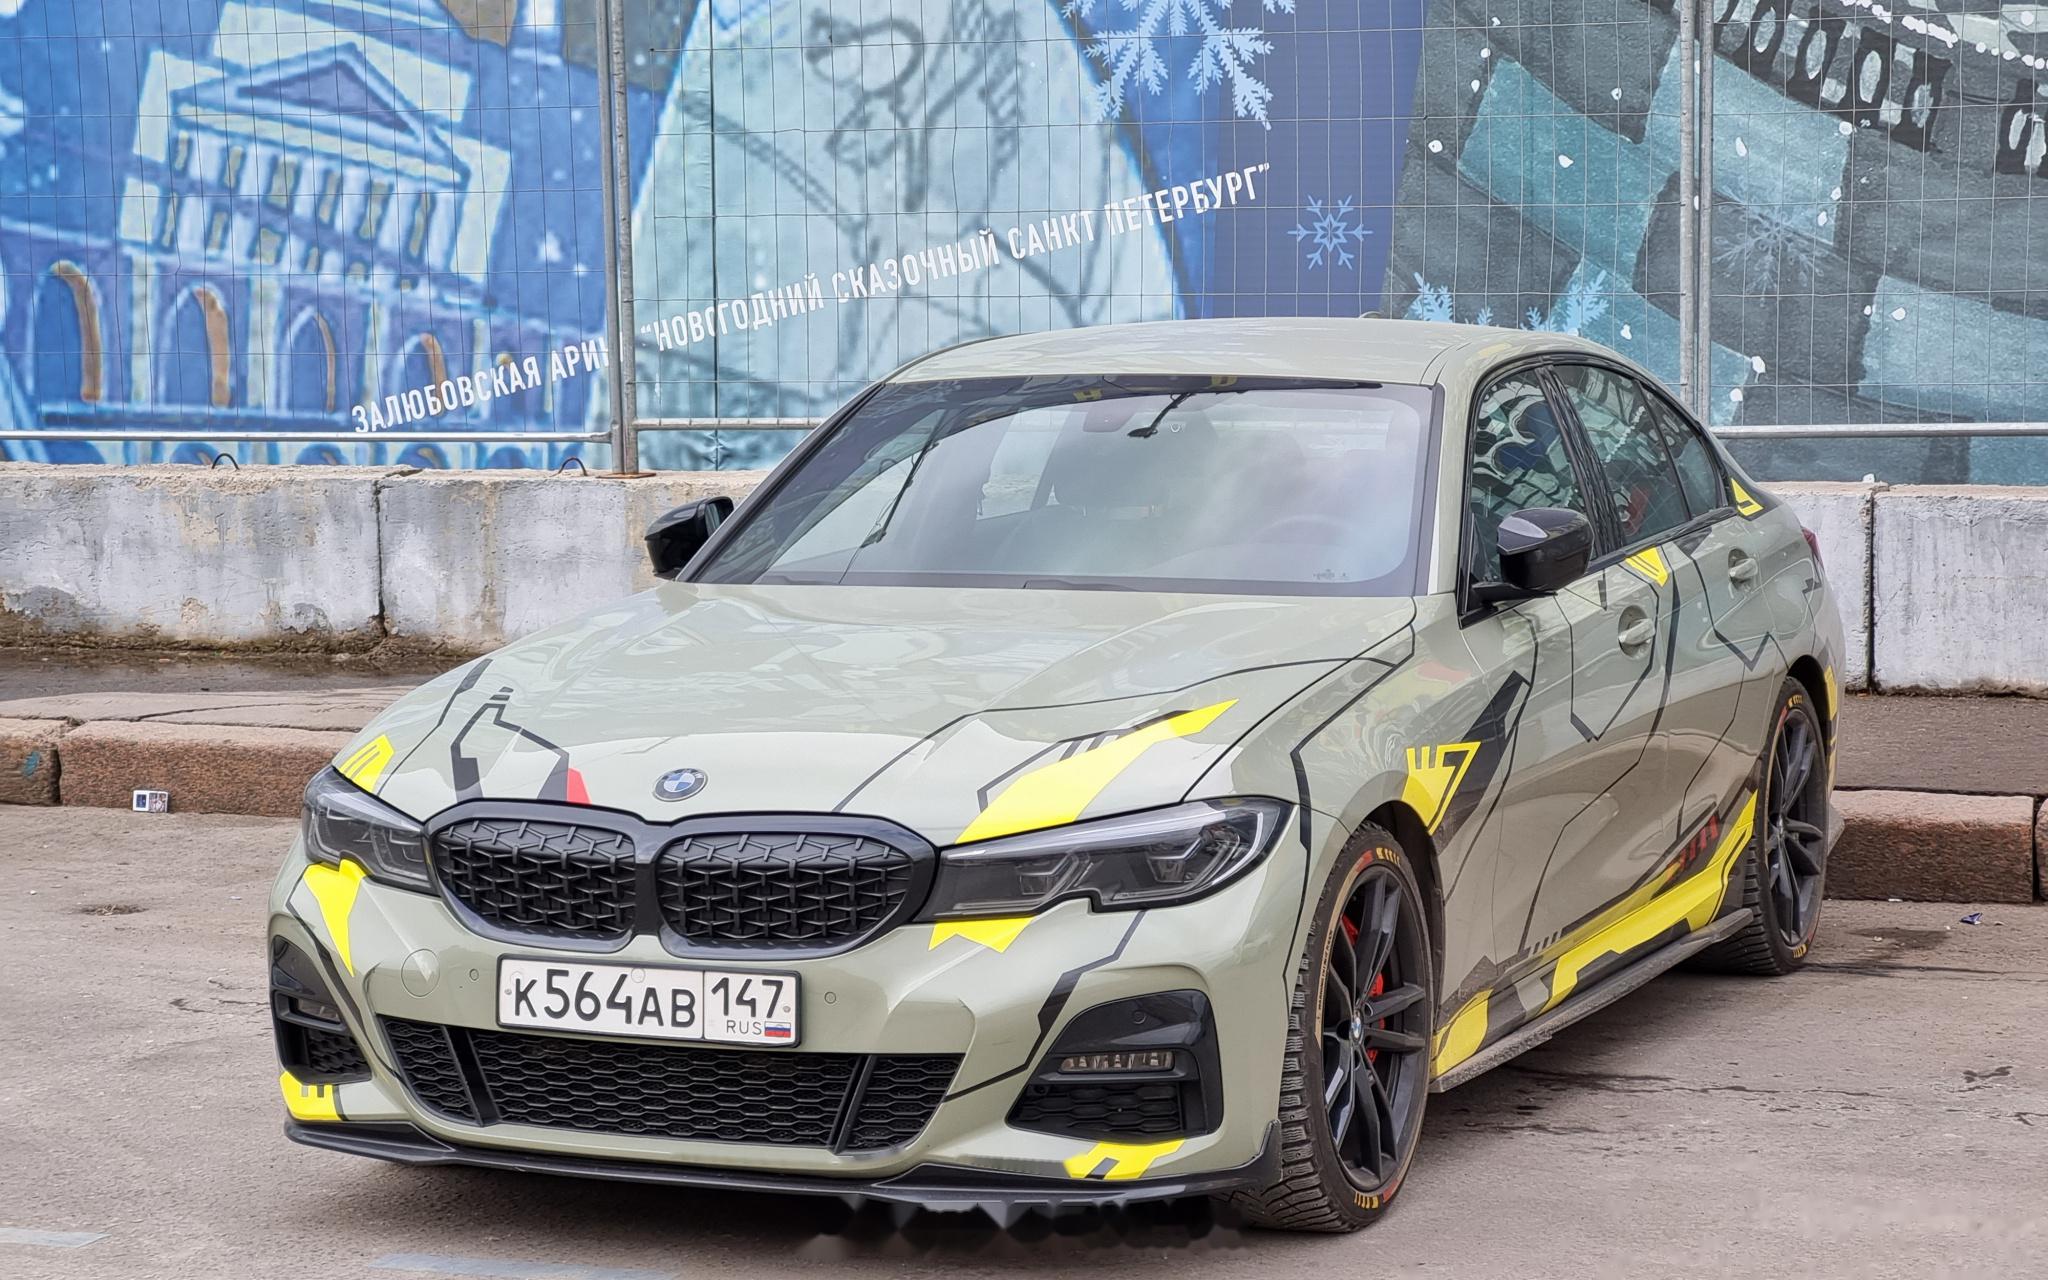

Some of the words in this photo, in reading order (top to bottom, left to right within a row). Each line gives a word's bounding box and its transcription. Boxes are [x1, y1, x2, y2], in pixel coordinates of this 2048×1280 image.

[351, 355, 542, 433] ЗАЛЮБОВСКАЯ
[551, 335, 624, 382] АРИ
[831, 227, 1000, 303] СКАЗОЧНЫЙ
[1007, 210, 1095, 260] САНКТ
[711, 977, 784, 1019] 147
[726, 1020, 762, 1035] RUS
